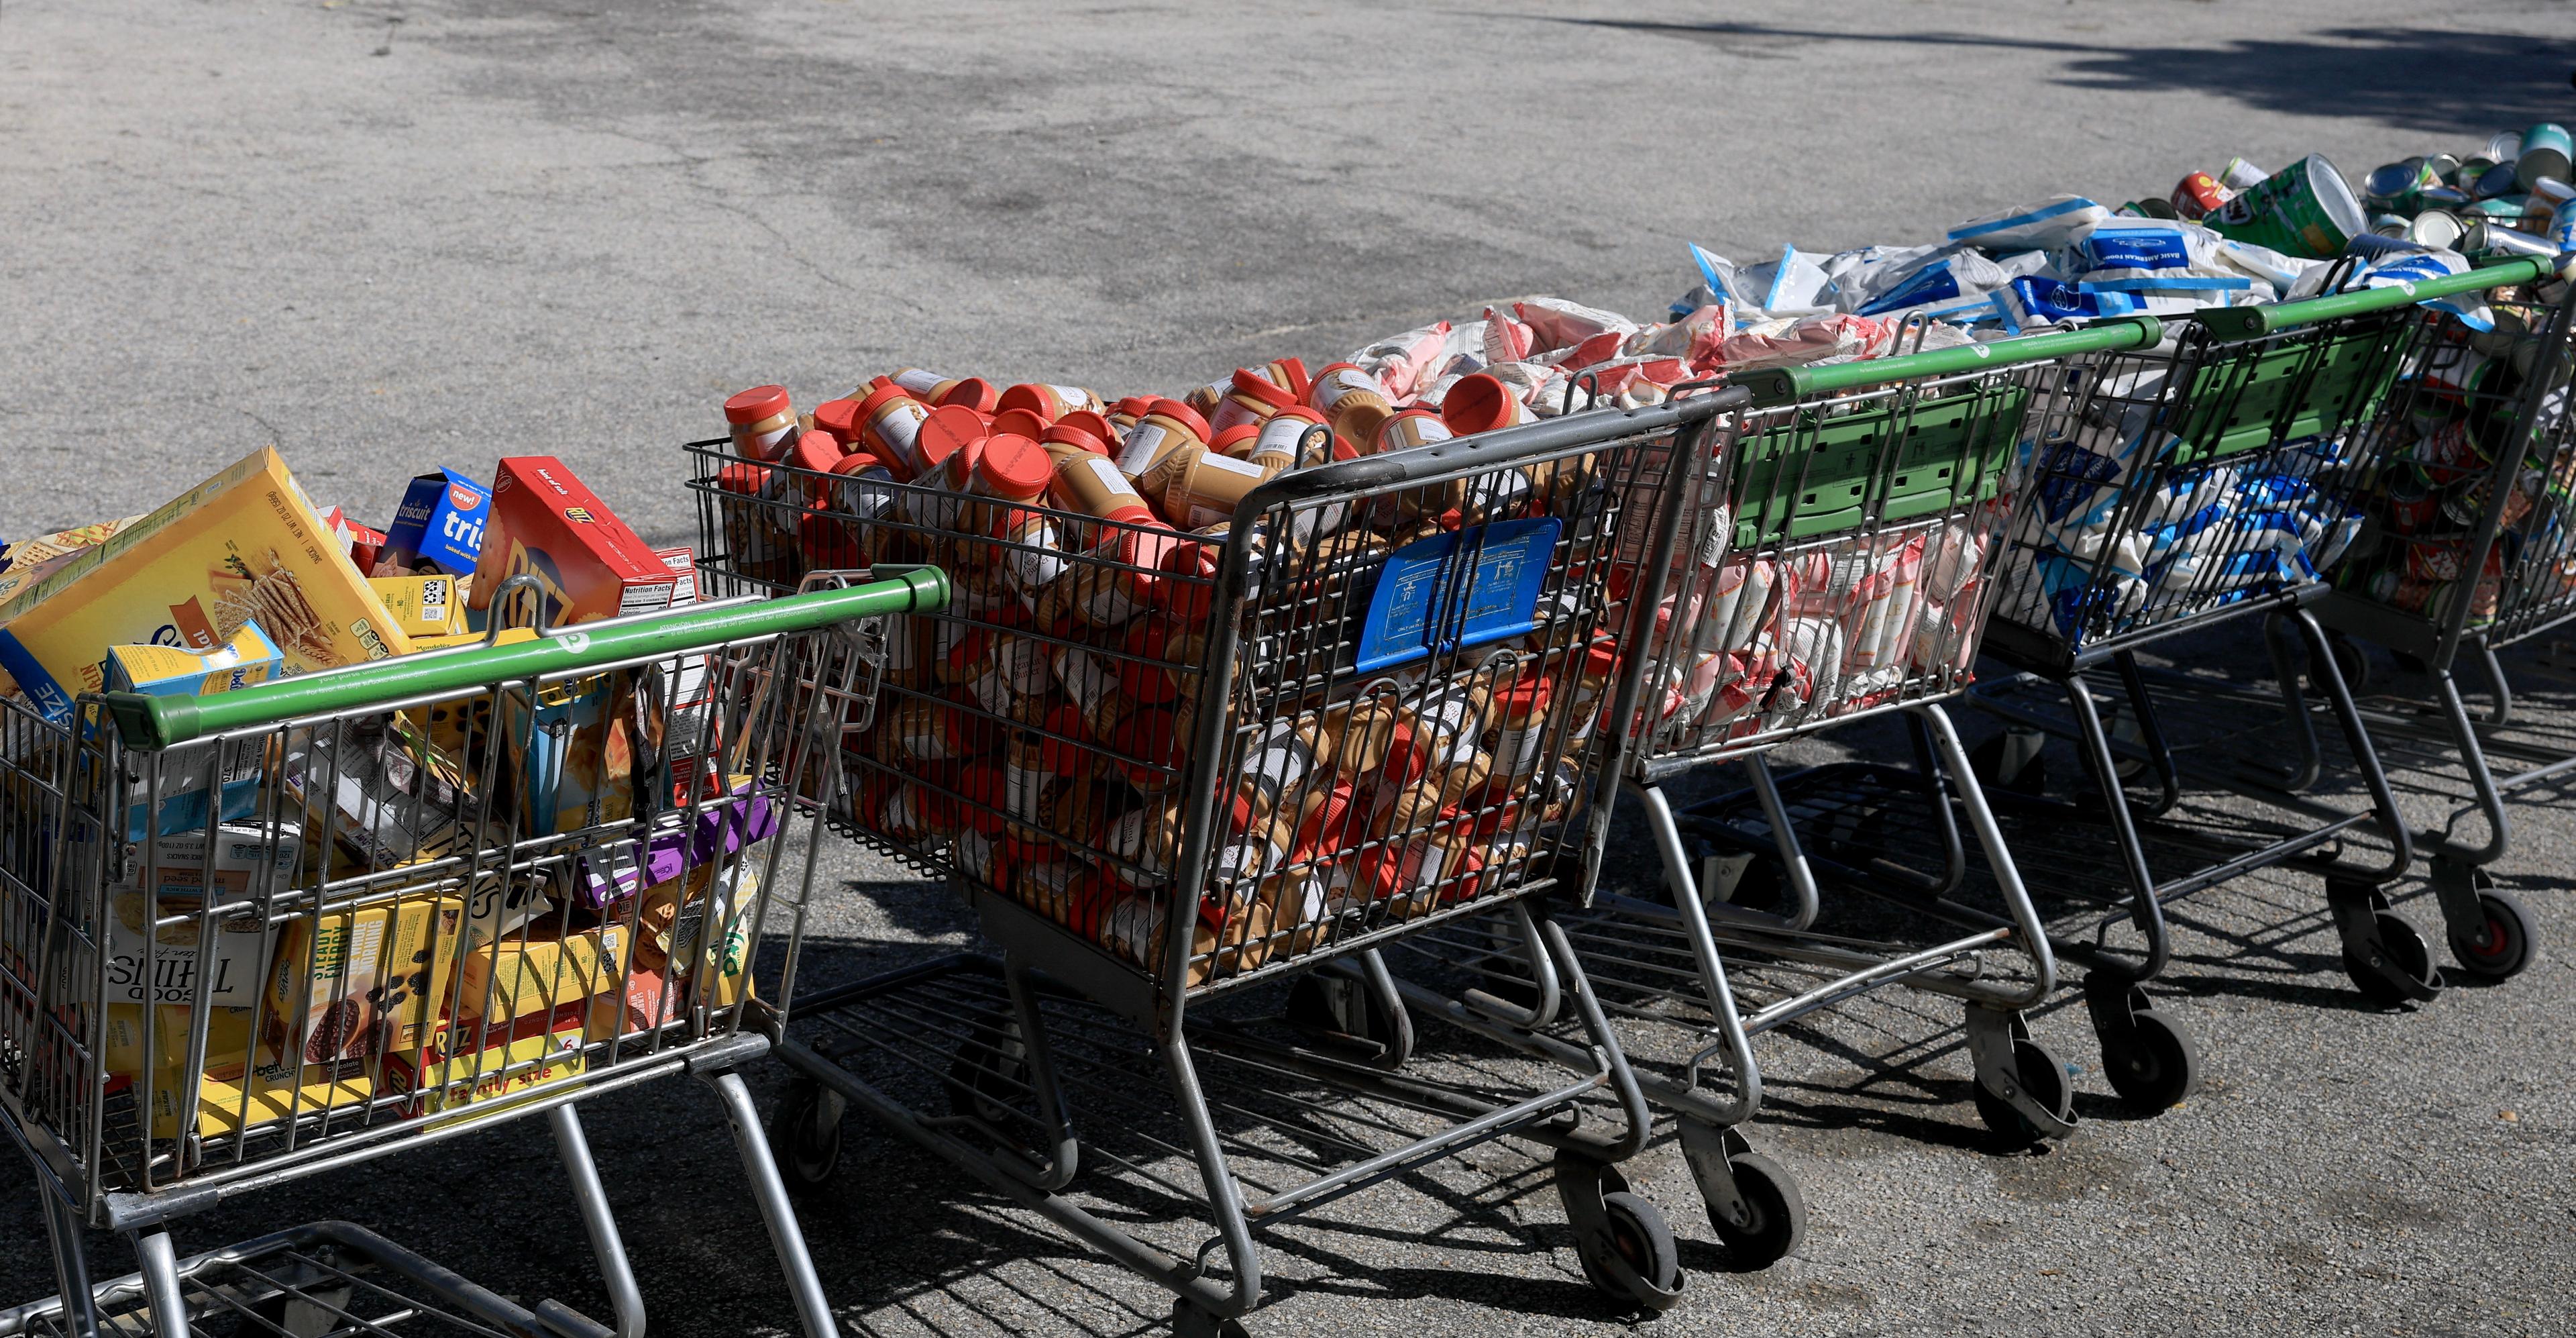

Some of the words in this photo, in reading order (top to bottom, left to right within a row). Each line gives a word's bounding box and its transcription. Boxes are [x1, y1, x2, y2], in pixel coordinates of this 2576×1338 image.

[2124, 254, 2159, 262] AMERICAN
[537, 468, 552, 480] hint
[497, 477, 511, 490] NABISCO
[453, 490, 476, 505] new!
[398, 502, 431, 521] triscuit
[565, 507, 596, 523] RITZ
[286, 520, 297, 531] WT
[292, 527, 304, 539] NET
[305, 546, 323, 564] SNACKS
[445, 544, 460, 555] baked
[460, 550, 472, 560] with
[673, 556, 689, 564] Facts
[676, 577, 692, 586] Facts
[625, 586, 653, 595] Nutrition
[685, 625, 704, 634] llevado
[318, 676, 336, 684] your
[338, 671, 361, 681] purse
[362, 663, 410, 675] unattended.
[1014, 667, 1040, 680] Buter
[34, 682, 74, 727] SIZE
[222, 766, 233, 783] 370
[157, 841, 175, 849] (100g
[164, 875, 188, 883] seed
[314, 928, 333, 980] STEADY
[323, 926, 350, 980] ENERGY
[359, 919, 384, 975] MORNING
[278, 958, 291, 1004] belVita
[436, 1025, 472, 1053] RTZ
[563, 1039, 574, 1051] 6
[326, 1060, 359, 1072] Ccolate
[518, 1066, 552, 1086] size
